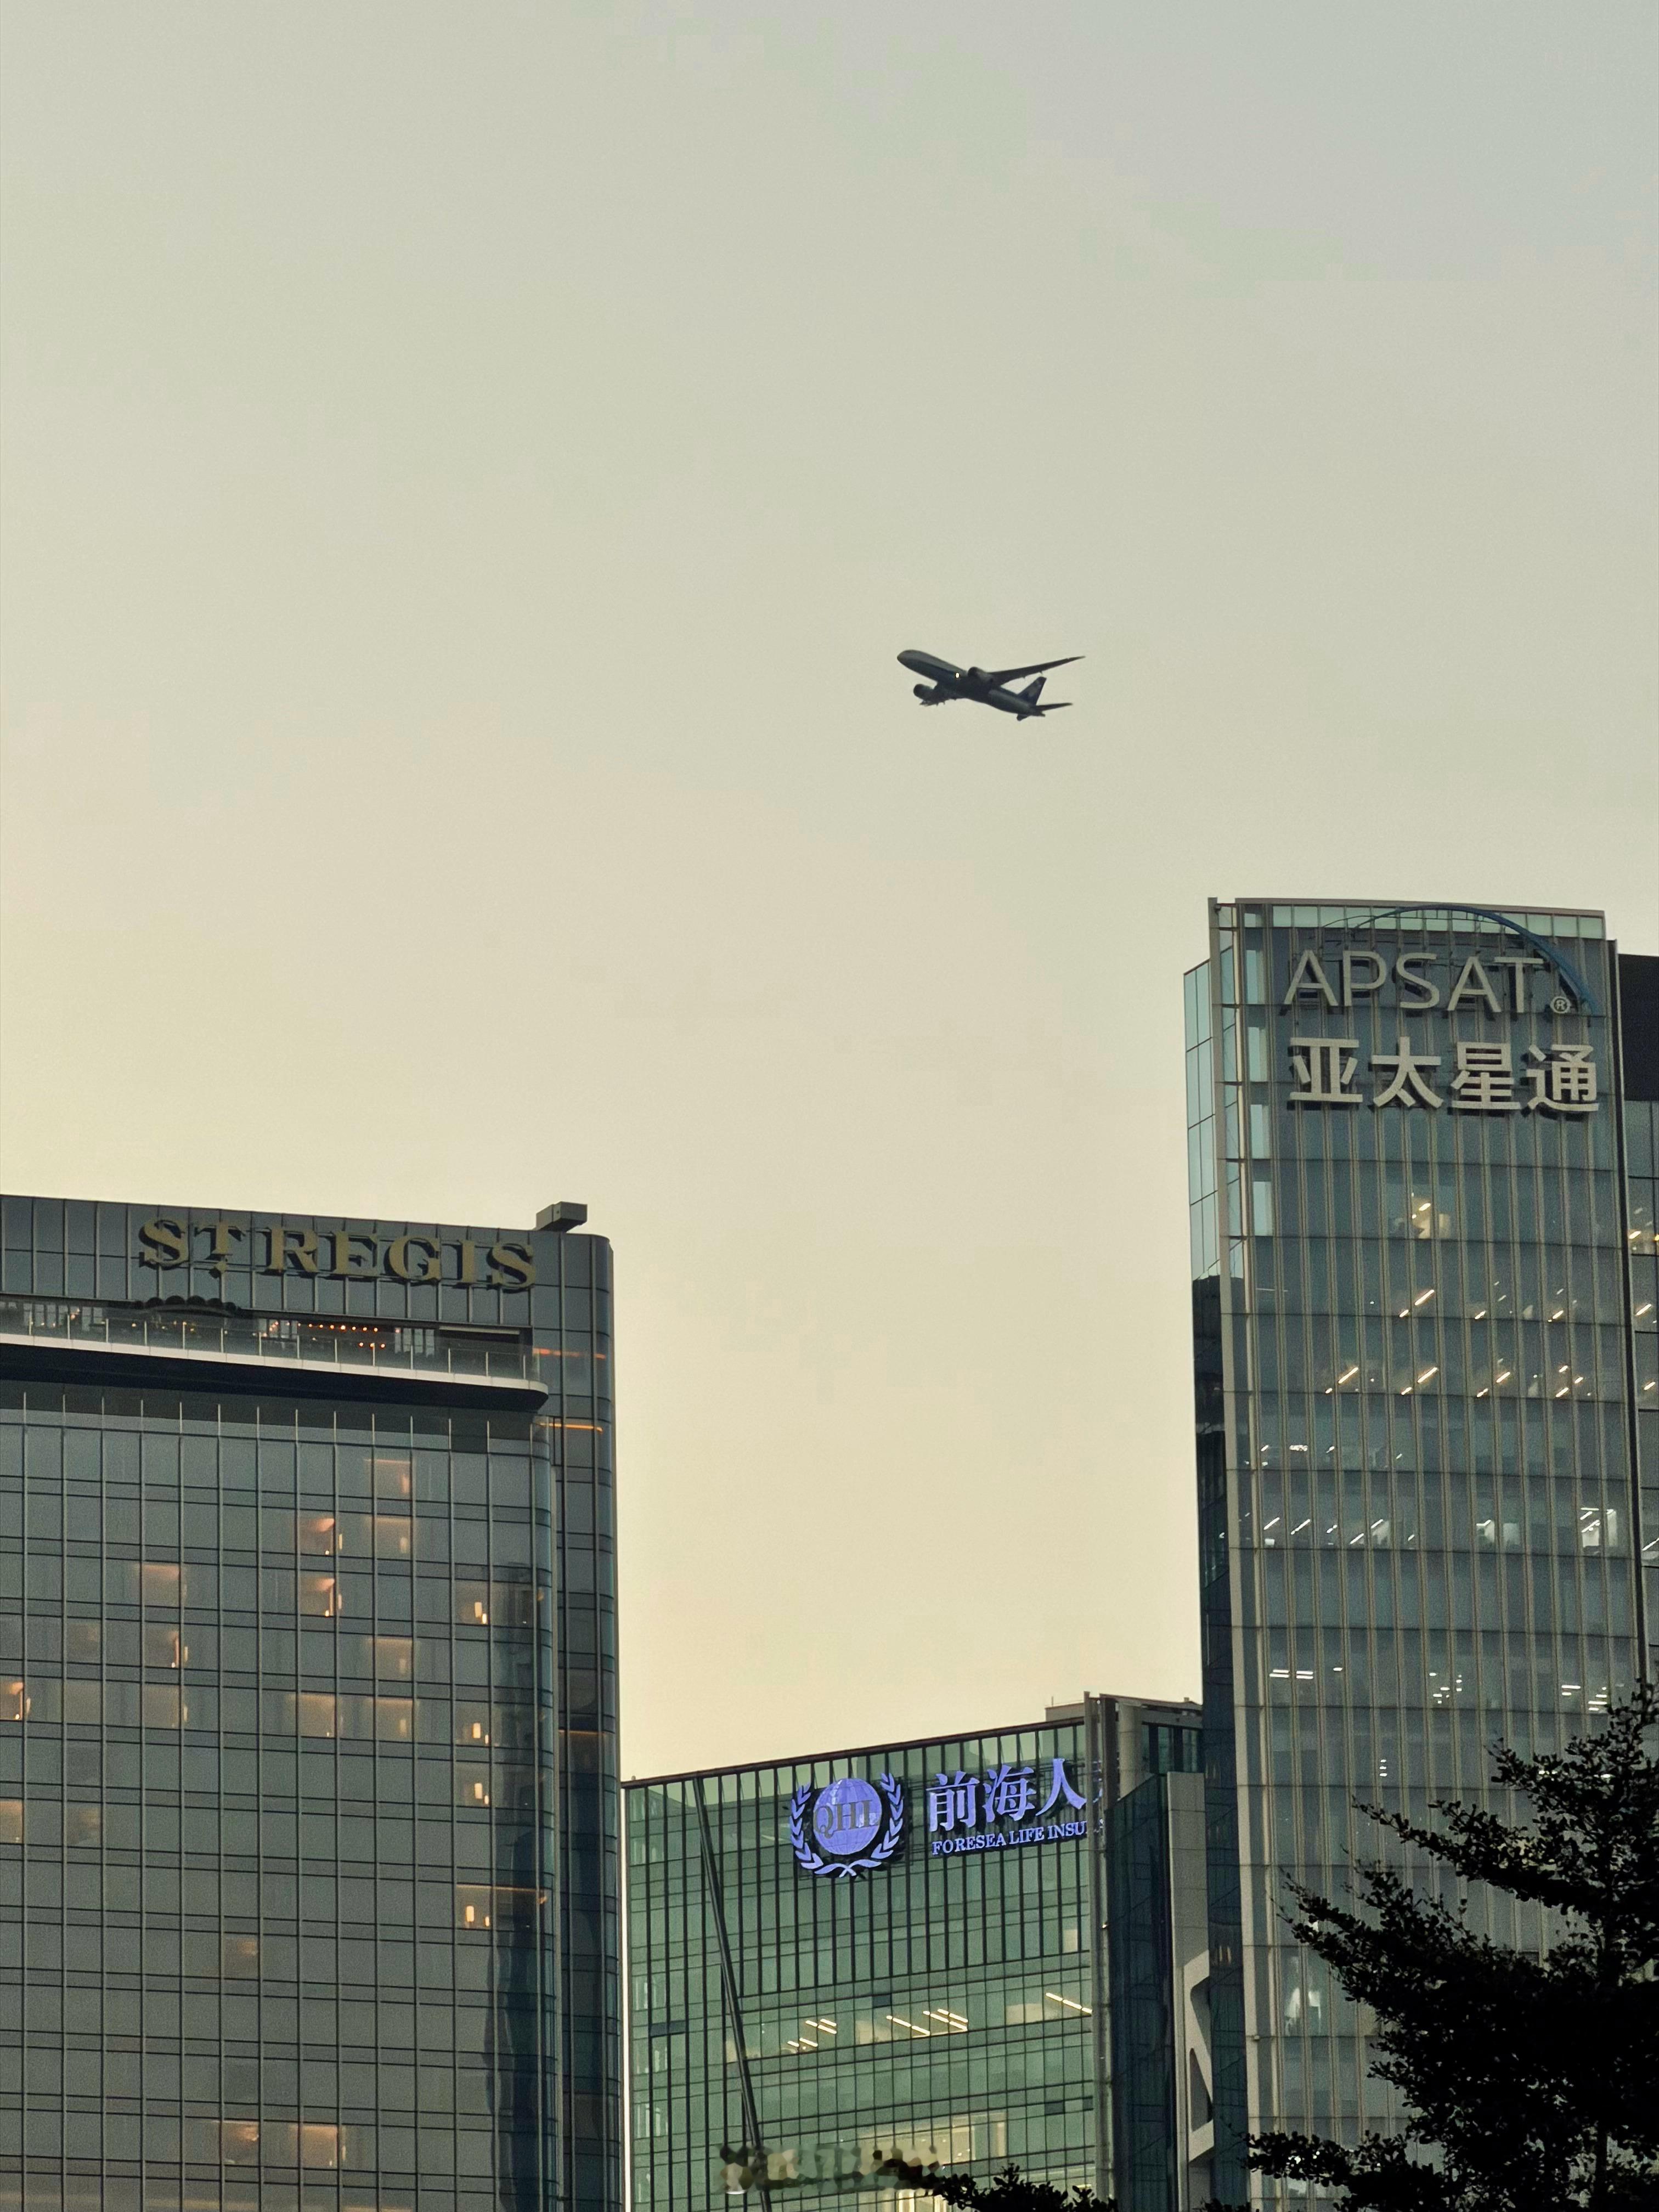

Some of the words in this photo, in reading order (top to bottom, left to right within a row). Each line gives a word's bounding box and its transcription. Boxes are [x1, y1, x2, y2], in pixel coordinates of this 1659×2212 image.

[1289, 1036, 1599, 1112] 亚太星通
[261, 1227, 537, 1289] REGIS
[926, 1758, 1103, 1832] 前海人
[932, 1833, 1006, 1856] FORESEA
[1008, 1827, 1045, 1845] LIFE
[1047, 1820, 1088, 1839] INSU
